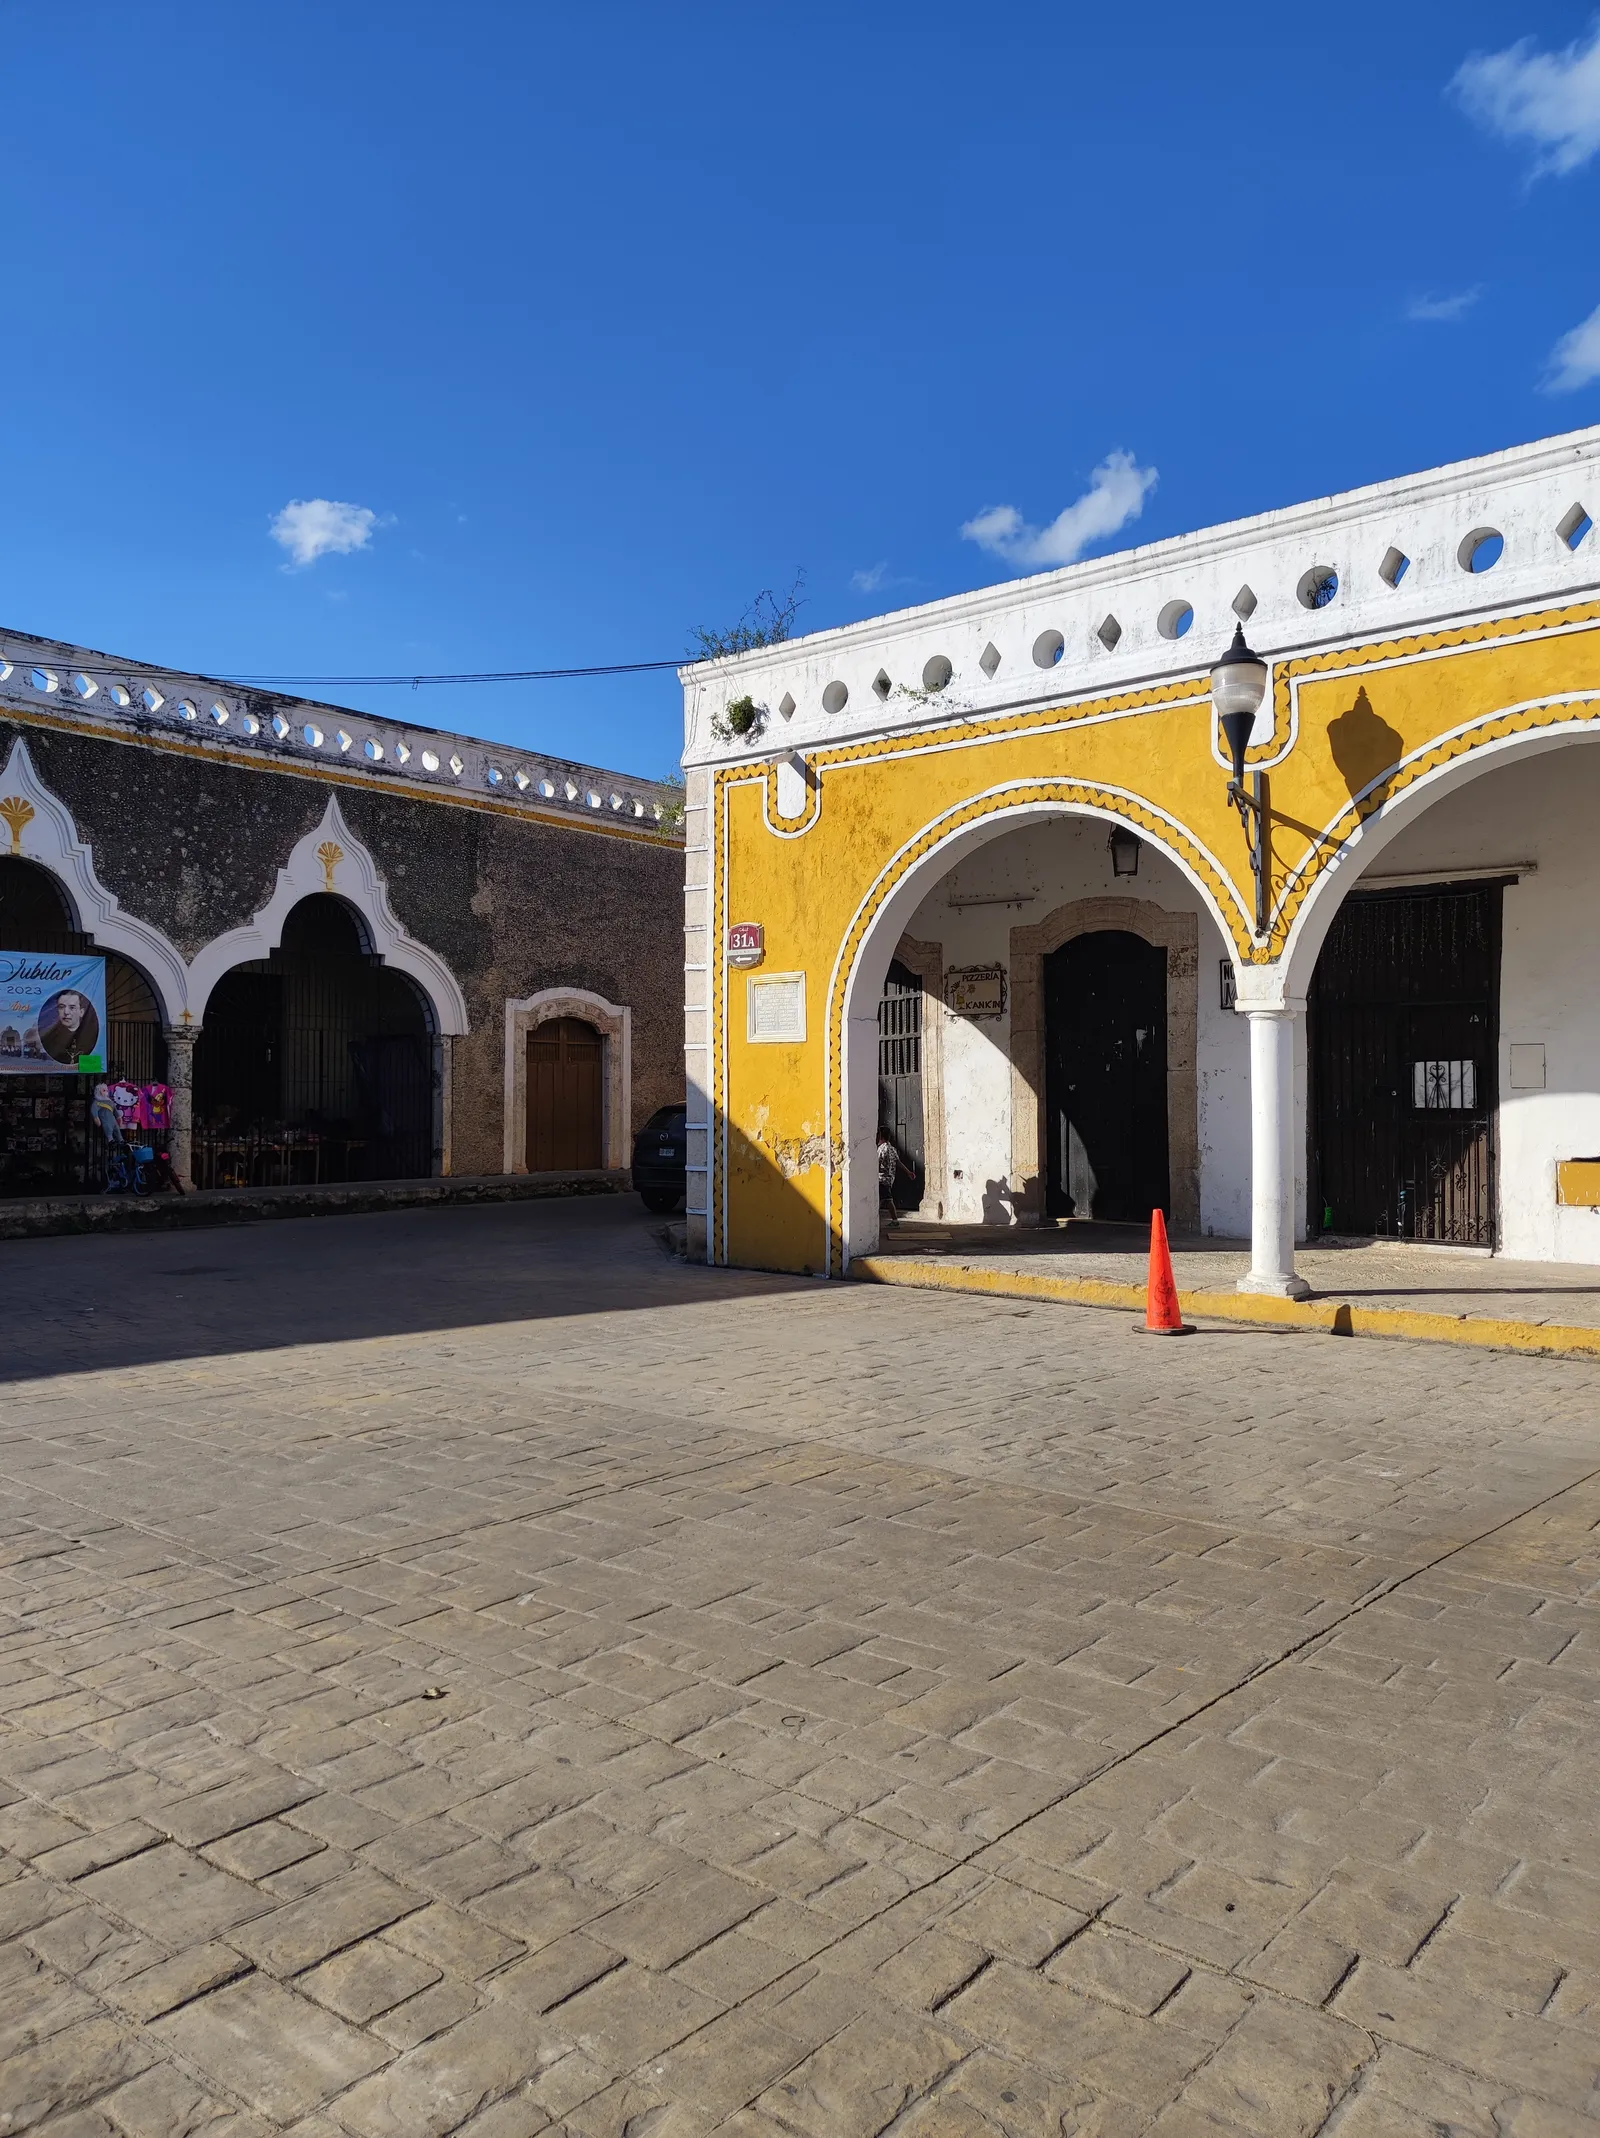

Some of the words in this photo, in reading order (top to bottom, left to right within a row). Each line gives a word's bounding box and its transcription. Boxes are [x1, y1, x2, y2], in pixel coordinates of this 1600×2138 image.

[733, 933, 754, 948] 31A
[0, 957, 72, 983] Jubilar
[962, 972, 999, 982] PIZZERÍA
[7, 986, 42, 995] 2023
